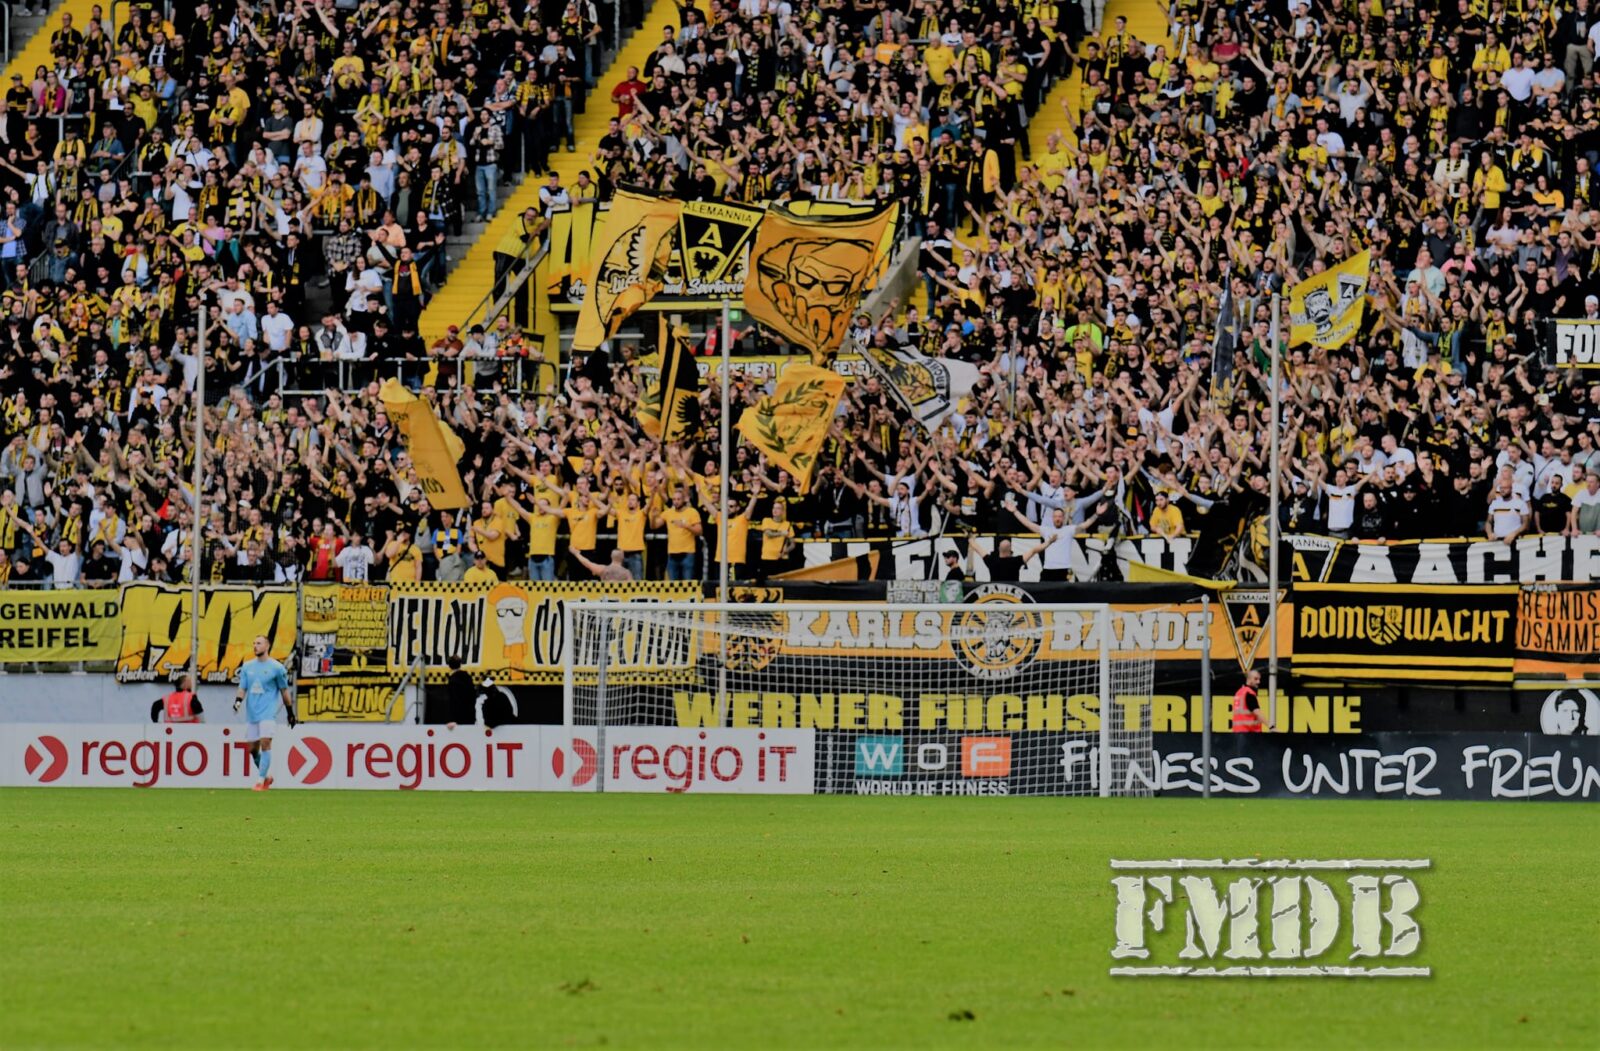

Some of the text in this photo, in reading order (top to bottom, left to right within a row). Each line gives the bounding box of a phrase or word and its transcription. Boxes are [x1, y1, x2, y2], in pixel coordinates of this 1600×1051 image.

[683, 202, 753, 223] ALEMANNIA
[698, 223, 723, 249] A
[0, 602, 119, 620] GENWALD
[1241, 605, 1260, 626] A
[1404, 607, 1510, 644] WACHT
[0, 627, 98, 648] REIFEL
[391, 598, 484, 666] YELLOW
[787, 611, 1213, 650] KARLS BANDE
[673, 692, 903, 730] WERNER
[82, 728, 208, 787] regio
[347, 729, 471, 789] regio
[613, 732, 743, 792] regio
[1060, 740, 1261, 794] FITNESS
[1282, 746, 1442, 795] UNTER
[856, 781, 1008, 796] WORLD OF FITNESS
